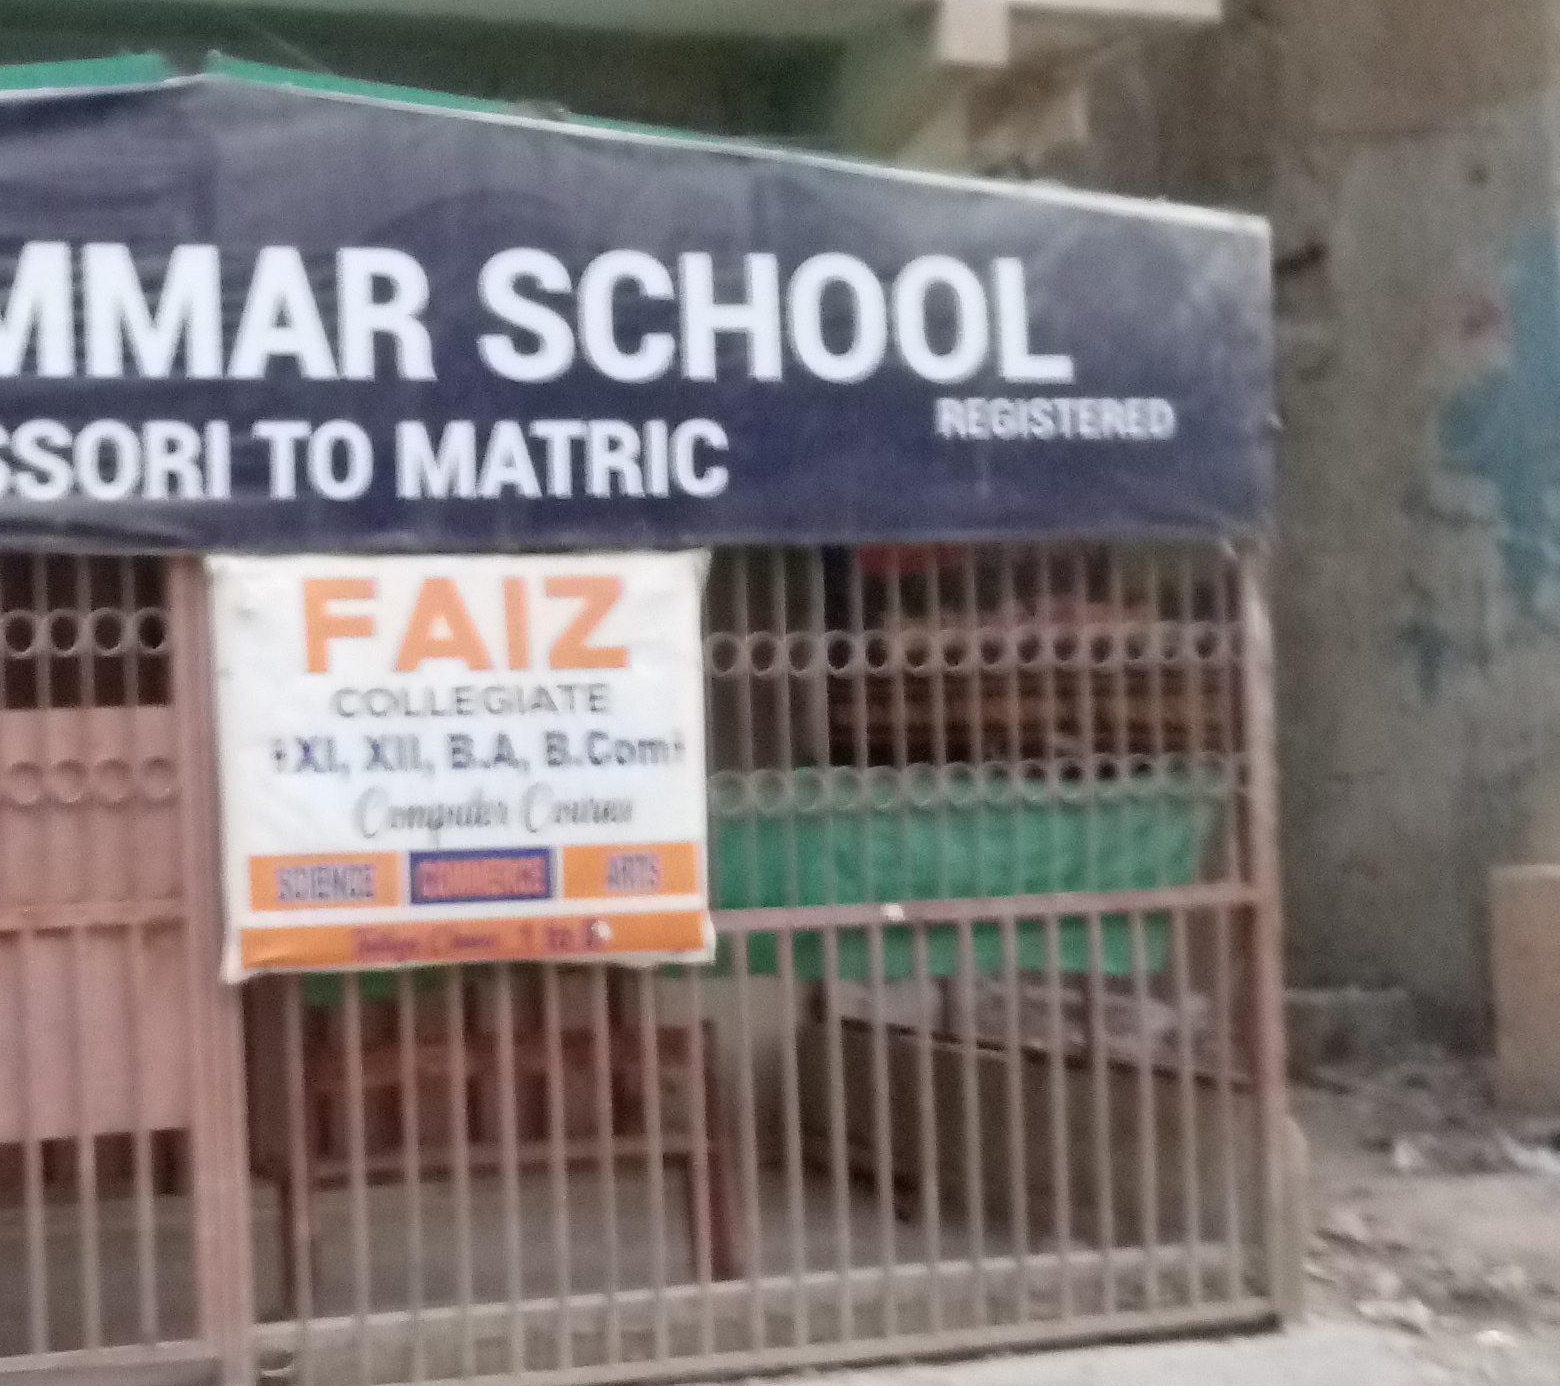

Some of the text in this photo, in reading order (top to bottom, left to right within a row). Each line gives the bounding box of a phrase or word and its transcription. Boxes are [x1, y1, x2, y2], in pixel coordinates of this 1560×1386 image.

[476, 249, 1074, 385] SCHOOL
[252, 418, 372, 502] TO
[395, 418, 729, 499] MATRIC
[935, 397, 1174, 440] REGISTERED
[303, 575, 629, 673] FAIZ
[335, 682, 608, 717] COLLEGIATE
